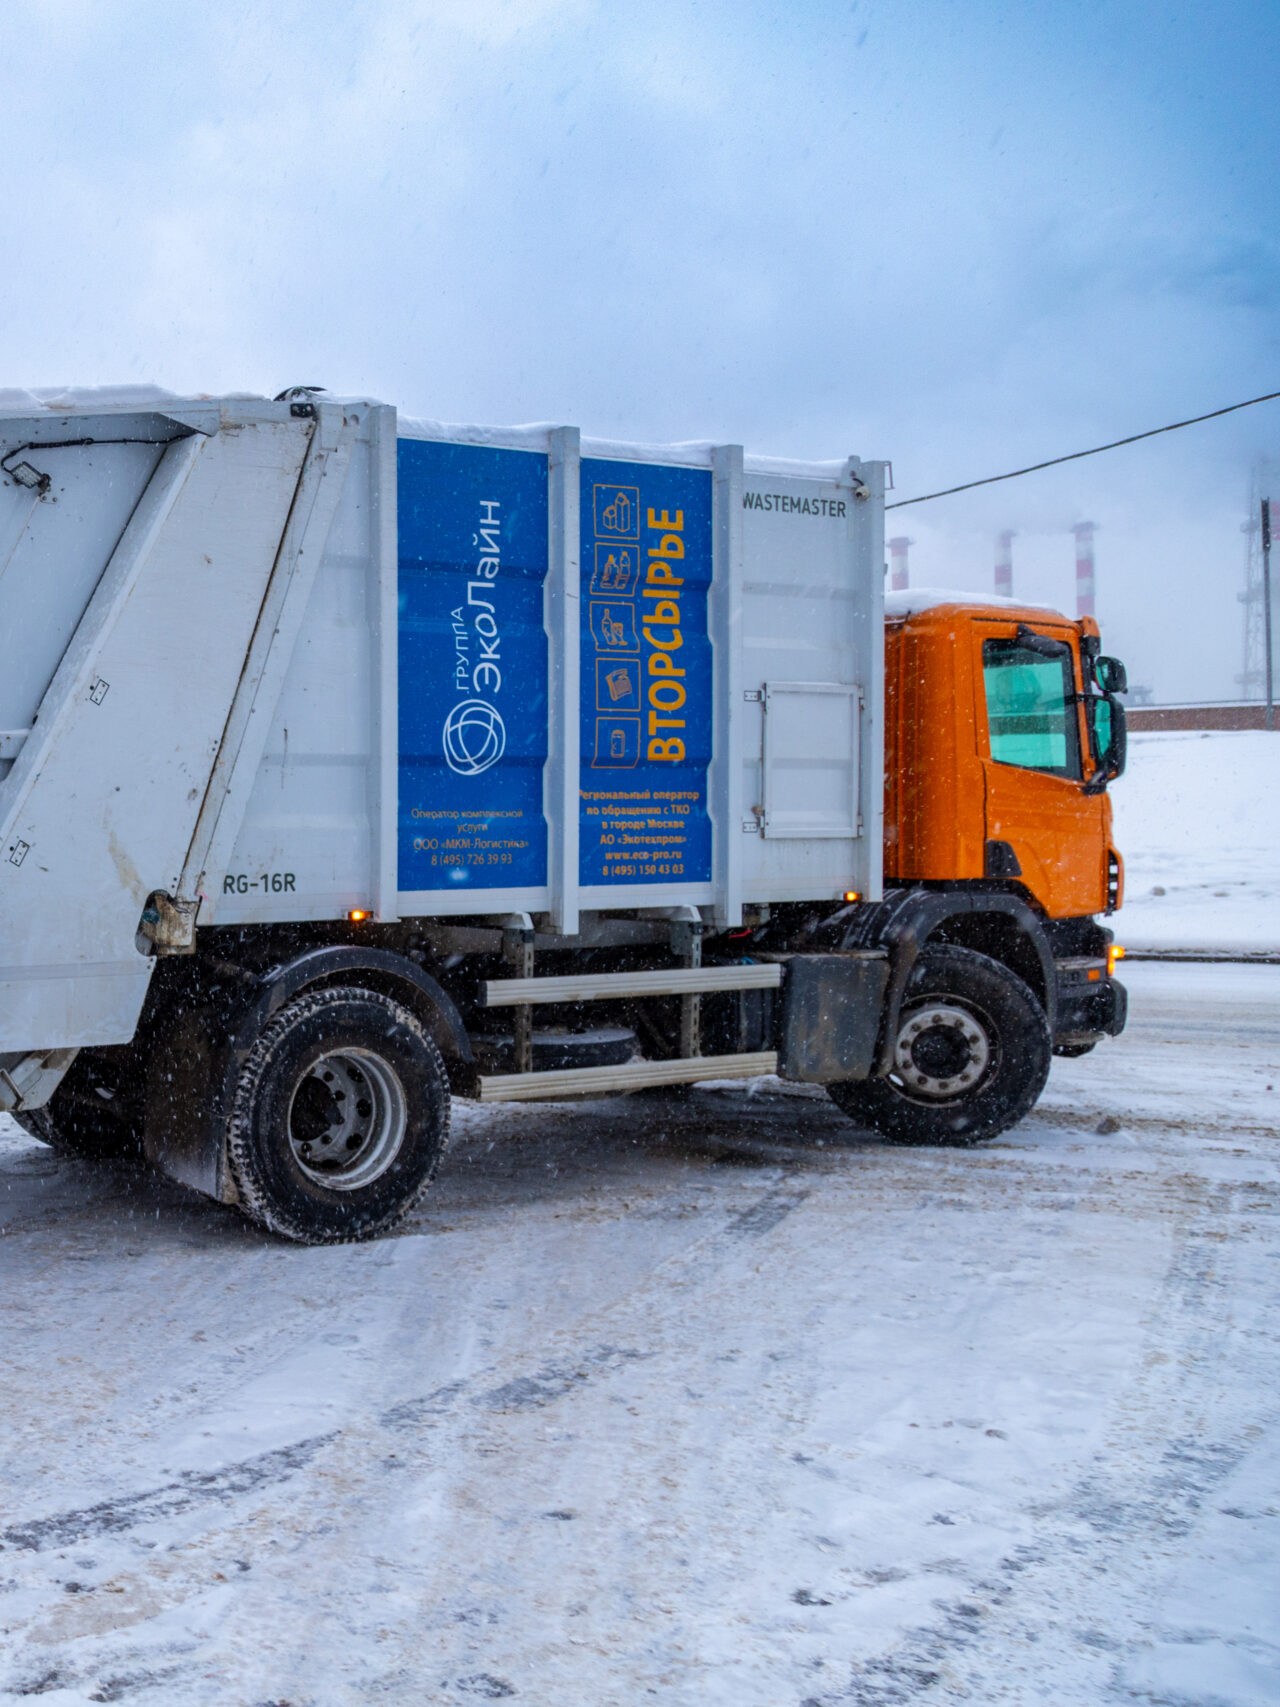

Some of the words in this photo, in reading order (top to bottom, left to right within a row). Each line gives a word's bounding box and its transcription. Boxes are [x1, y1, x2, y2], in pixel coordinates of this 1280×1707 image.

[742, 491, 846, 518] WASTEMASTER
[467, 500, 502, 693] ЭкоЛайн
[642, 507, 687, 761] ВТОРСЫРЬЕ
[450, 606, 470, 690] ГРУППА
[652, 791, 700, 801] оператор
[411, 808, 460, 820] Оператор
[586, 807, 600, 815] по
[601, 804, 662, 816] обращению
[670, 804, 690, 814] ТКО
[457, 823, 488, 834] услуги
[601, 821, 608, 829] в
[610, 821, 646, 831] городе
[647, 819, 685, 828] Москве
[413, 838, 439, 850] ООО
[600, 834, 615, 845] АО
[431, 854, 438, 866] 8
[440, 854, 464, 866] (495)
[467, 853, 485, 865] 726
[487, 853, 499, 865] 39
[500, 853, 513, 865] 93
[605, 851, 682, 861] www.eco-pro.ru
[602, 865, 609, 876] 8
[611, 865, 637, 876] (495)
[639, 864, 657, 875] 150
[658, 864, 670, 875] 43
[672, 863, 685, 875] 03
[223, 873, 296, 895] RG-16R
